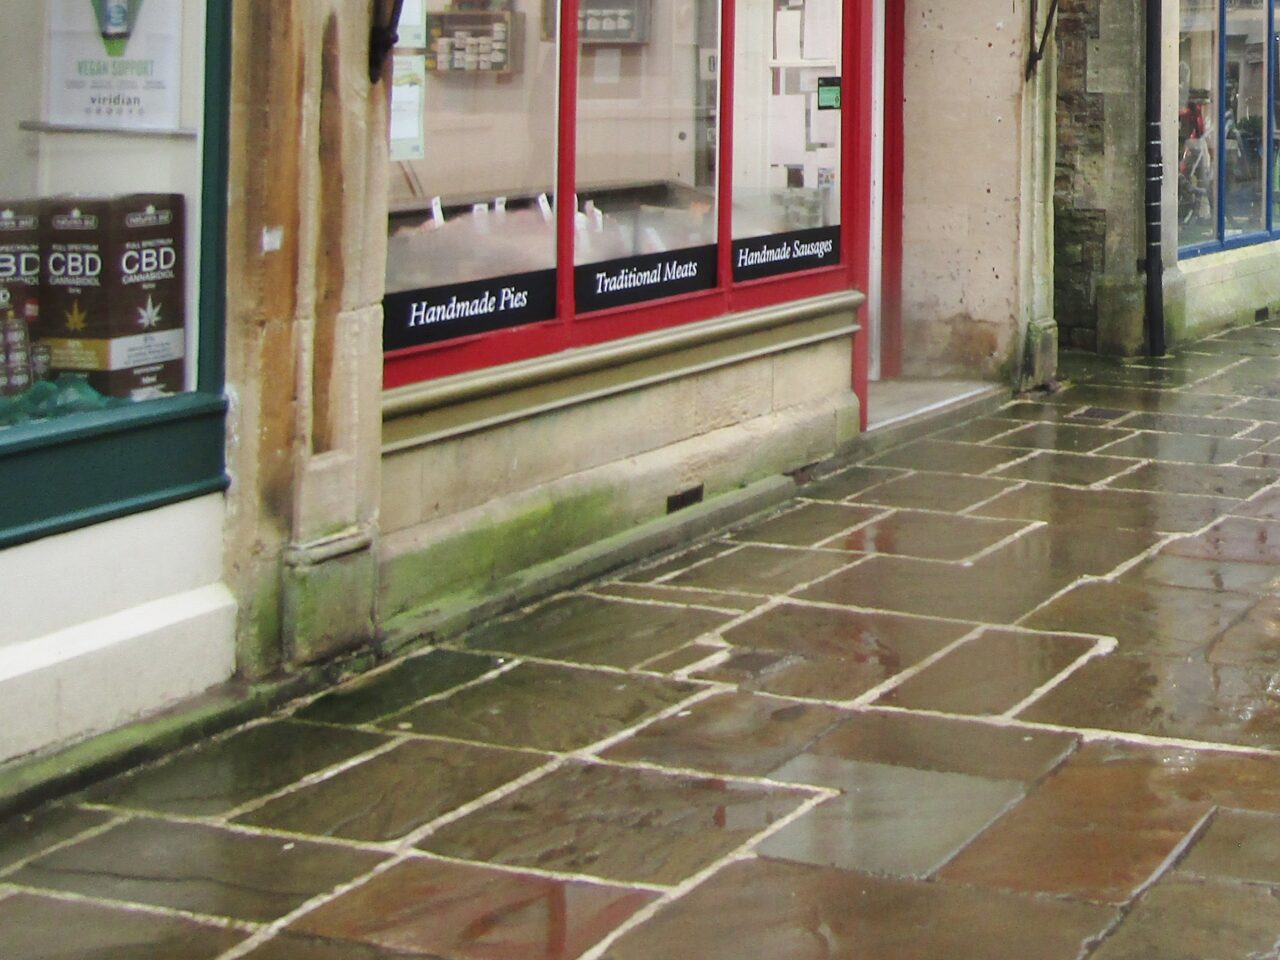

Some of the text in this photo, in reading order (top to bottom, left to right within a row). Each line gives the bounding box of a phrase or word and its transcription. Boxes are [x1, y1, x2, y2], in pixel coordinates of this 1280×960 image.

[78, 60, 155, 76] VEGAN SUPPORT
[90, 94, 141, 106] viridian
[0, 252, 40, 277] BD
[49, 252, 102, 277] CBD
[122, 247, 176, 275] CBD
[738, 239, 833, 268] Handmade Sausages
[596, 260, 698, 294] Traditional Meats
[408, 287, 528, 327] Handmade Pies
